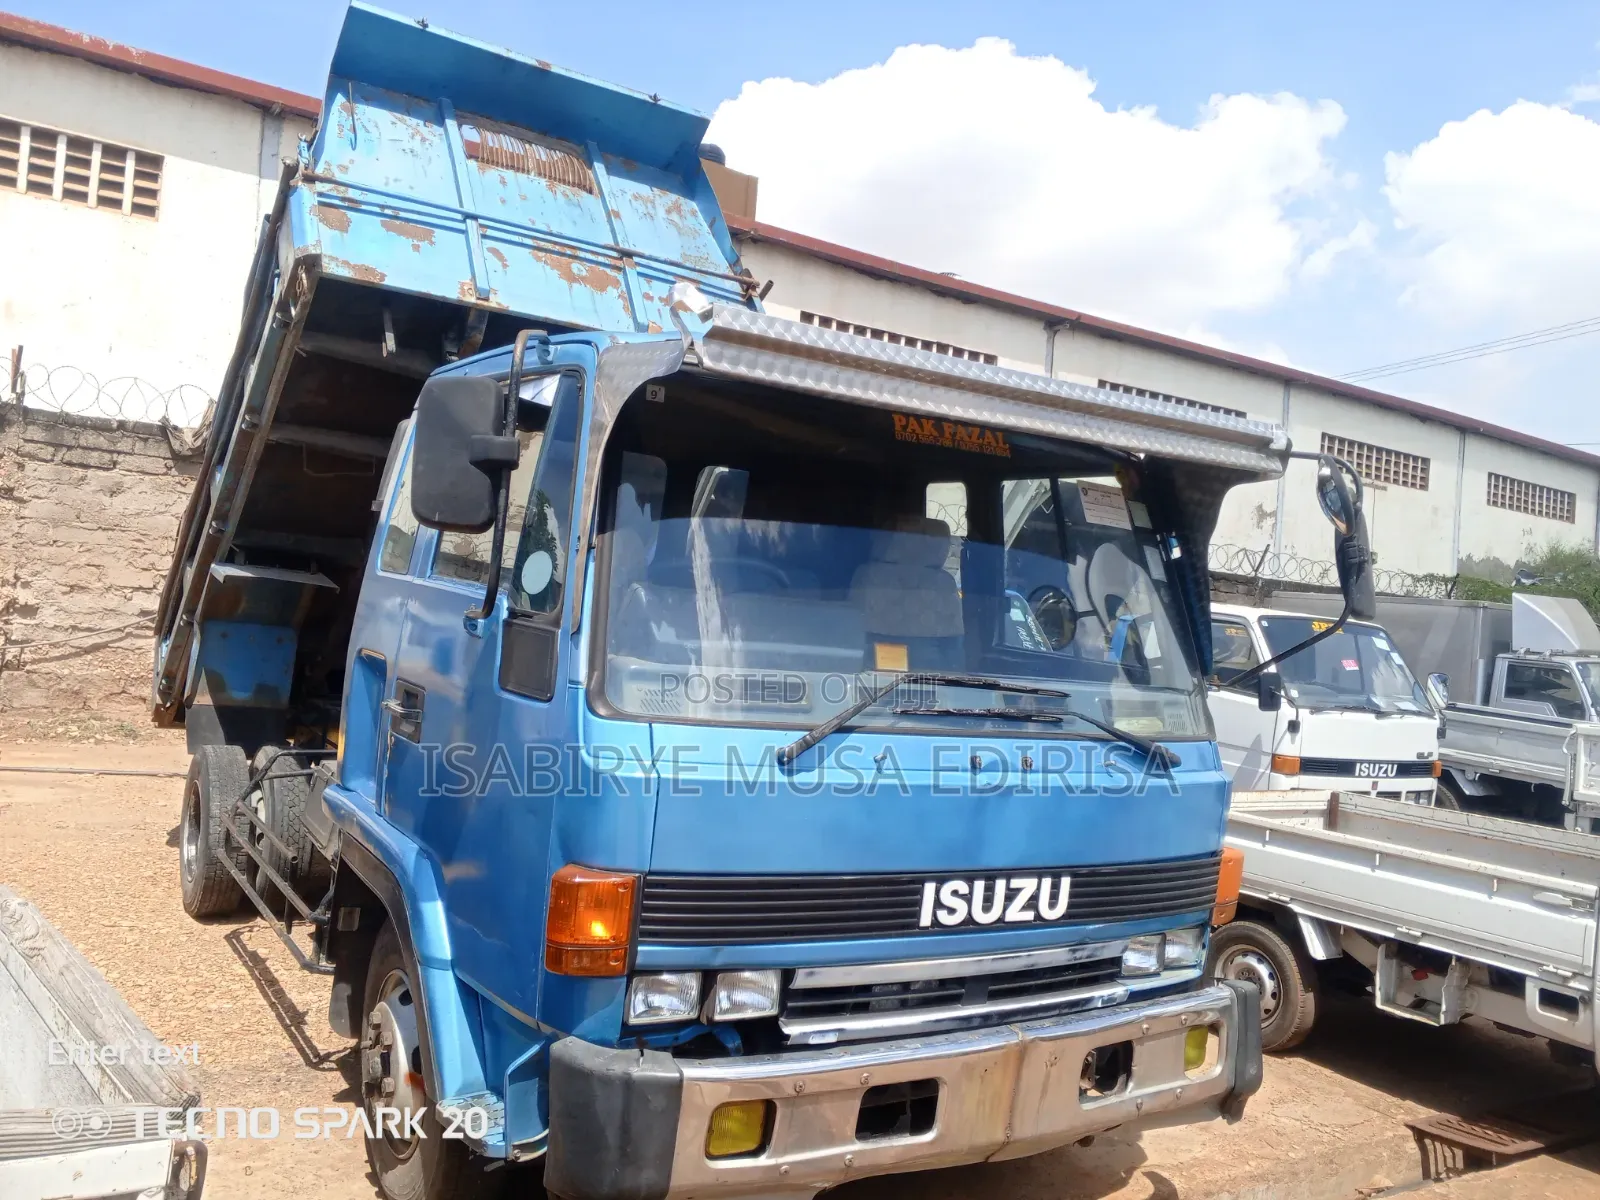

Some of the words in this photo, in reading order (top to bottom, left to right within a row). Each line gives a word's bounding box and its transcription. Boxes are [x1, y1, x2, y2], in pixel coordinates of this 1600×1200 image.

[892, 414, 939, 437] PAK
[942, 421, 1010, 449] FAZAL
[1355, 762, 1398, 778] ISUZU
[919, 876, 1071, 928] ISUZU
